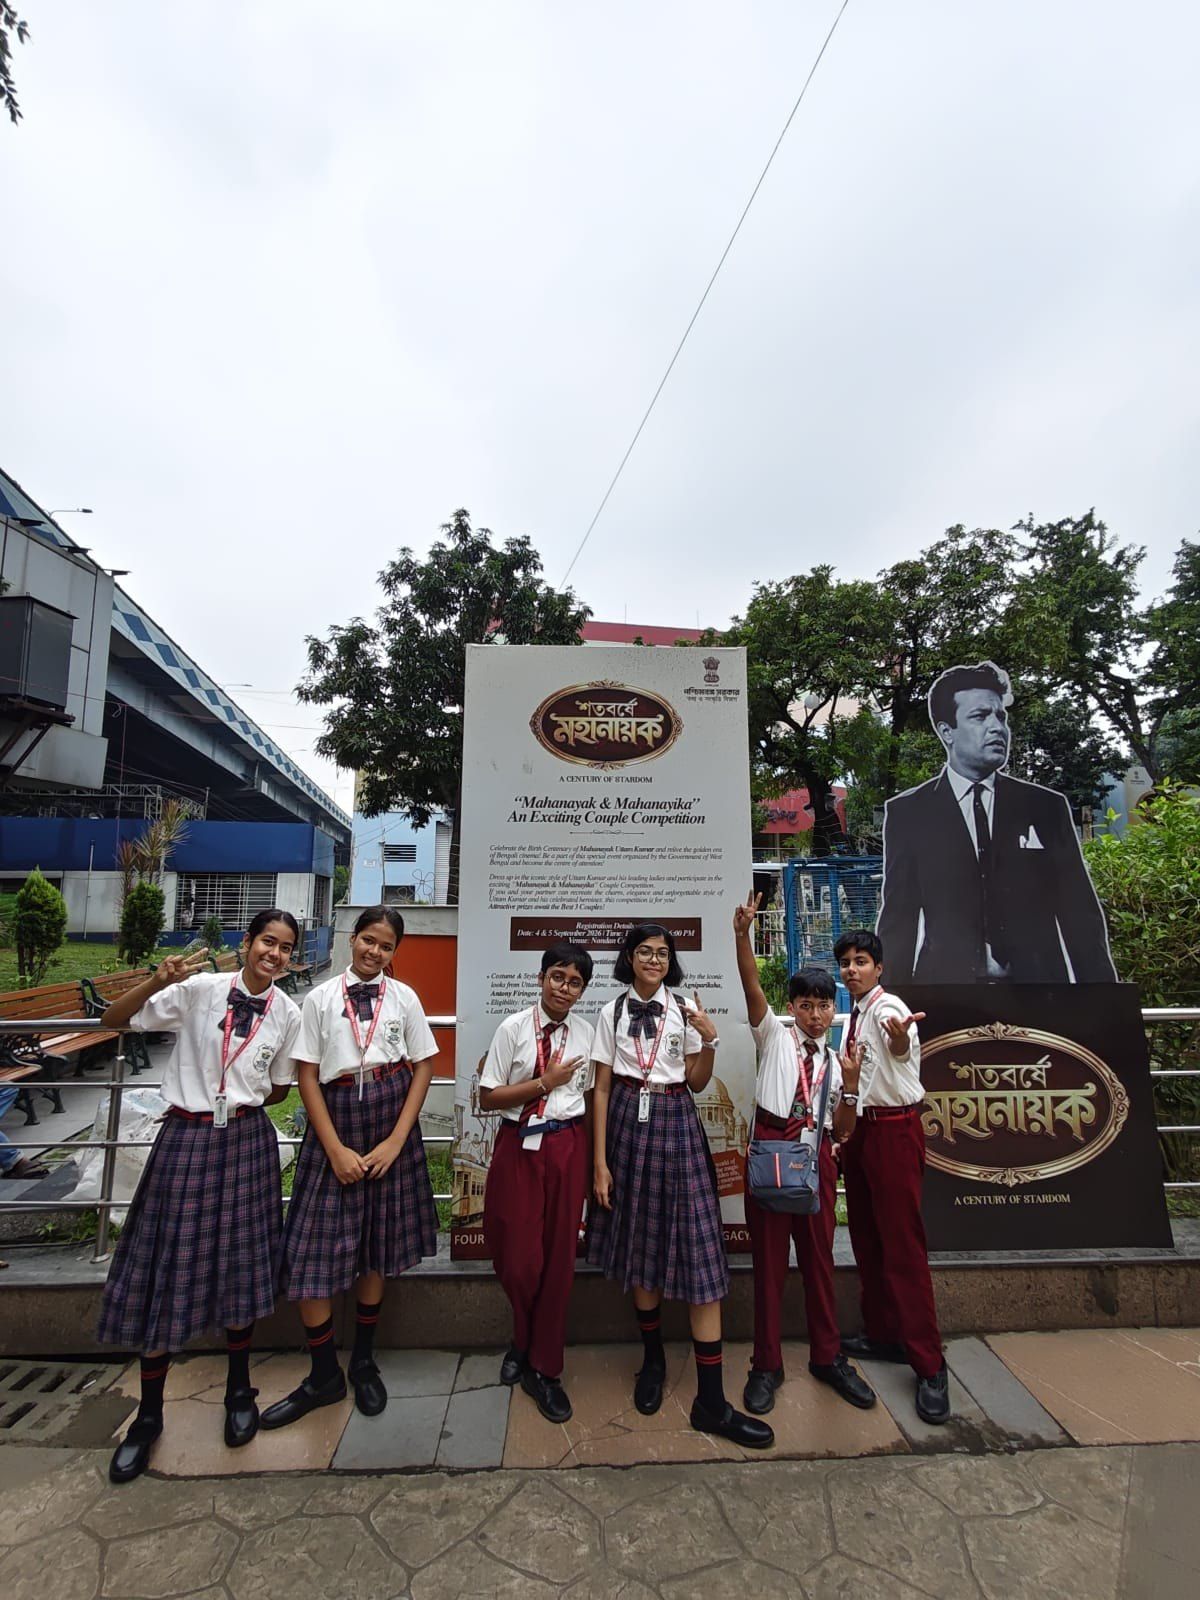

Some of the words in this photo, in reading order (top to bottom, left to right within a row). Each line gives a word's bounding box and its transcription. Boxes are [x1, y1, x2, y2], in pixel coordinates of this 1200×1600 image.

[575, 697, 638, 717] শতবর্ষে
[550, 713, 664, 748] মহানায়ক
[615, 776, 653, 784] STARDOM
[600, 797, 610, 809] &
[507, 810, 527, 823] An
[530, 810, 582, 826] Exciting
[584, 811, 628, 826] Couple
[631, 811, 706, 827] Competition
[576, 921, 612, 931] Registration
[554, 929, 586, 938] September
[683, 929, 696, 937] PM
[591, 936, 617, 944] Nandan
[490, 990, 512, 998] Antony
[717, 1007, 729, 1015] PM
[948, 1055, 1052, 1089] শতবর্ষে
[920, 1082, 1098, 1144] মহানায়ক
[954, 1196, 962, 1206] A
[963, 1195, 1008, 1206] CENTURY
[1009, 1194, 1022, 1204] OF
[1023, 1193, 1071, 1204] STARDOM
[454, 1234, 485, 1245] FOUR
[724, 1230, 752, 1241] GACY.
